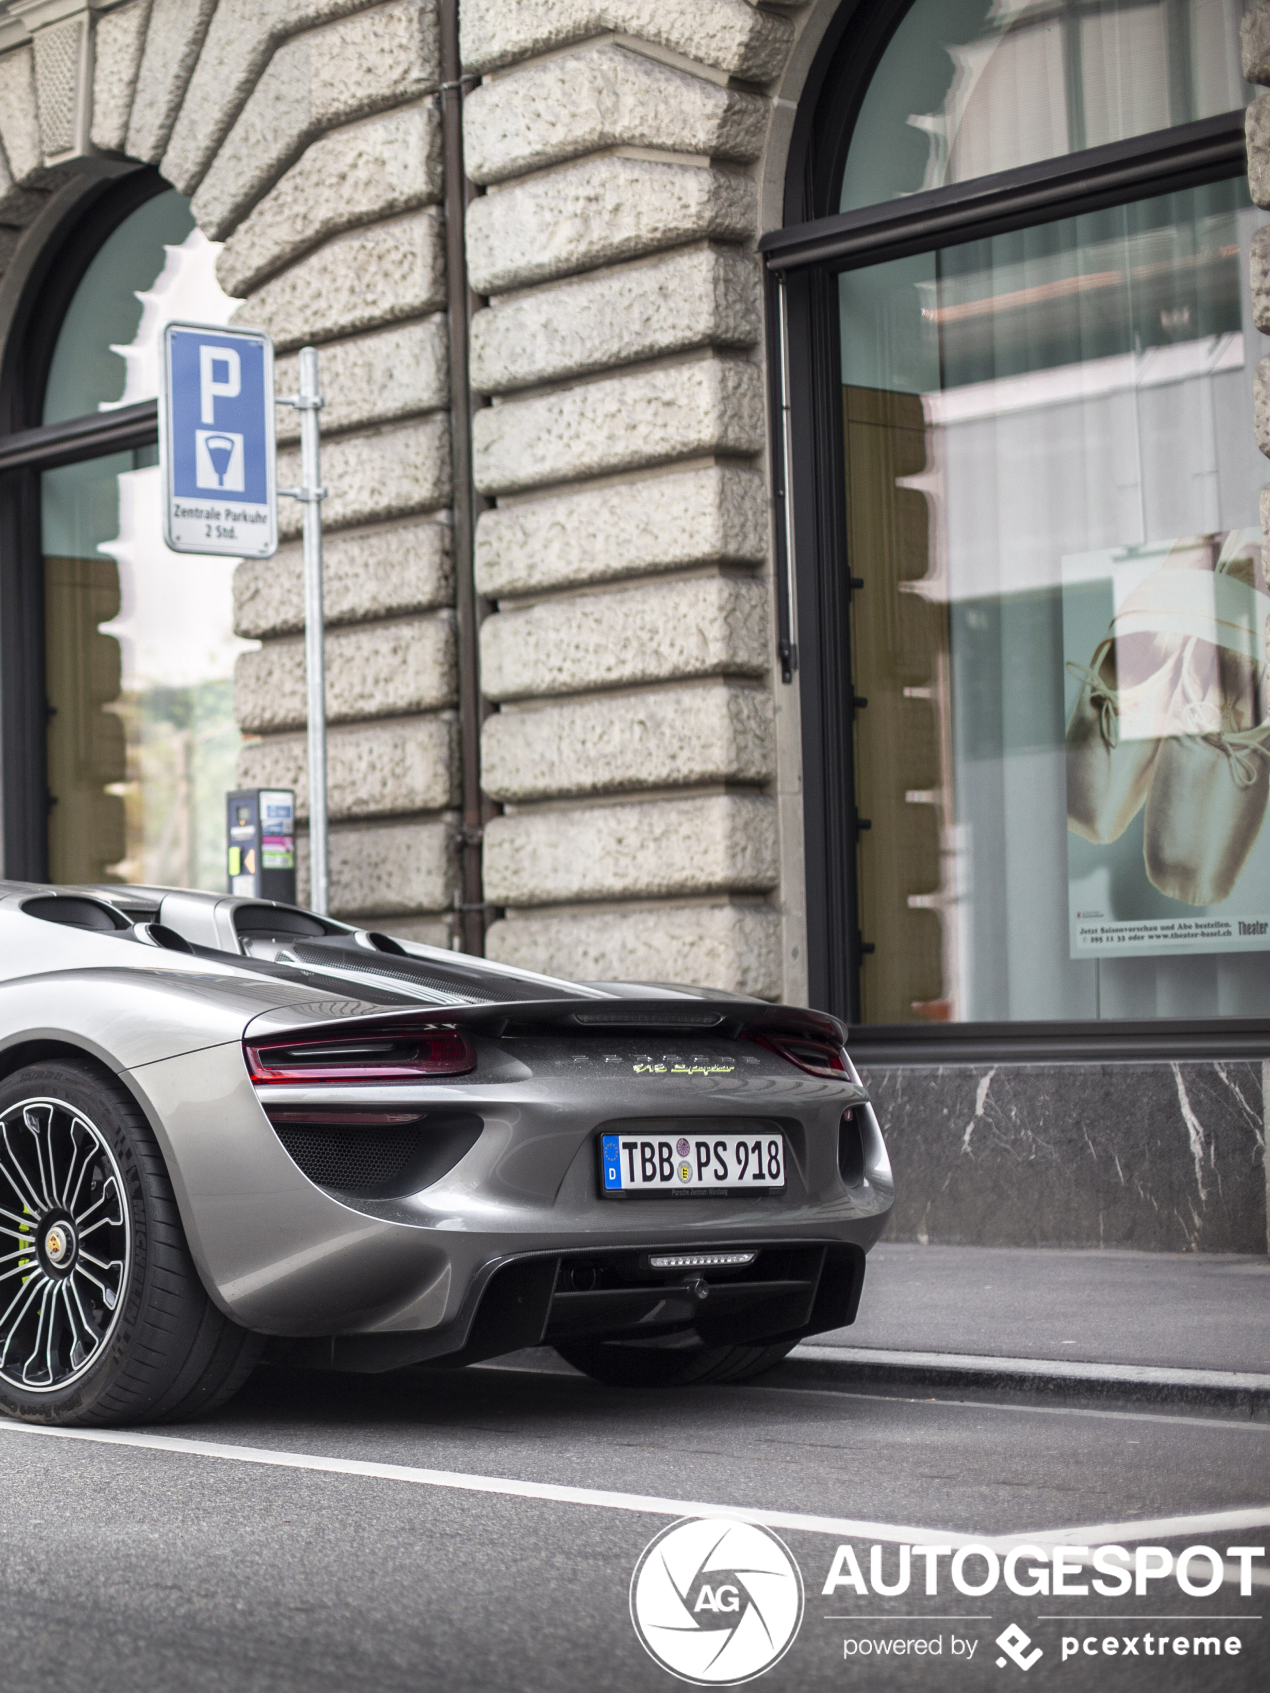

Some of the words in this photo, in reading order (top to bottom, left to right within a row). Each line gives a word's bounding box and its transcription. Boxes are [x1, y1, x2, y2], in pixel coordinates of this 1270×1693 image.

[200, 345, 240, 424] P
[174, 504, 221, 521] Zentrale
[225, 508, 267, 523] Parkuhr
[205, 525, 212, 537] 2
[216, 526, 238, 539] Std.
[1160, 923, 1175, 931] und
[1195, 921, 1232, 929] bestellen.
[1238, 920, 1268, 936] Theater
[622, 1141, 675, 1182] TBB
[695, 1140, 728, 1181] PS
[735, 1140, 781, 1180] 918
[609, 1168, 616, 1180] D
[124, 1199, 148, 1327] MICHELIN
